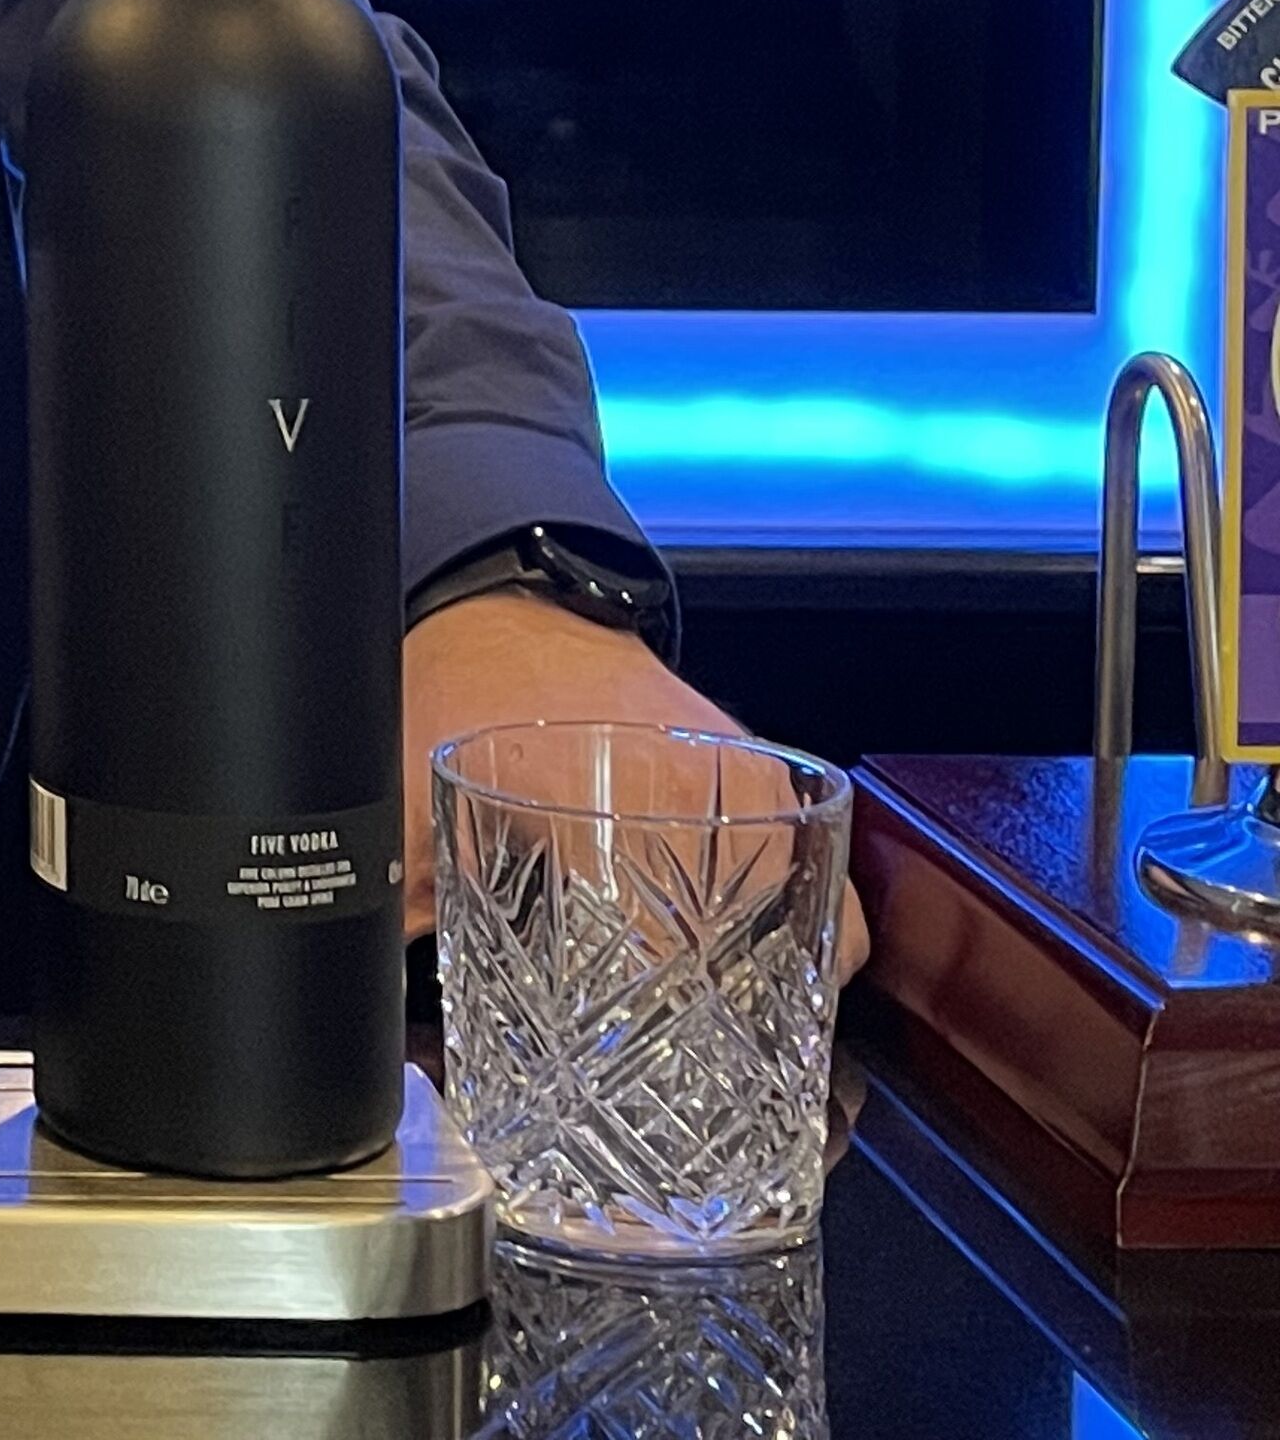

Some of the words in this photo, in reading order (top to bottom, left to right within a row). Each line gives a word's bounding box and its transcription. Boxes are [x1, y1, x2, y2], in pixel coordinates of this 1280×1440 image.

[266, 397, 310, 453] V
[250, 834, 286, 856] FIVE
[289, 829, 339, 854] VODKA
